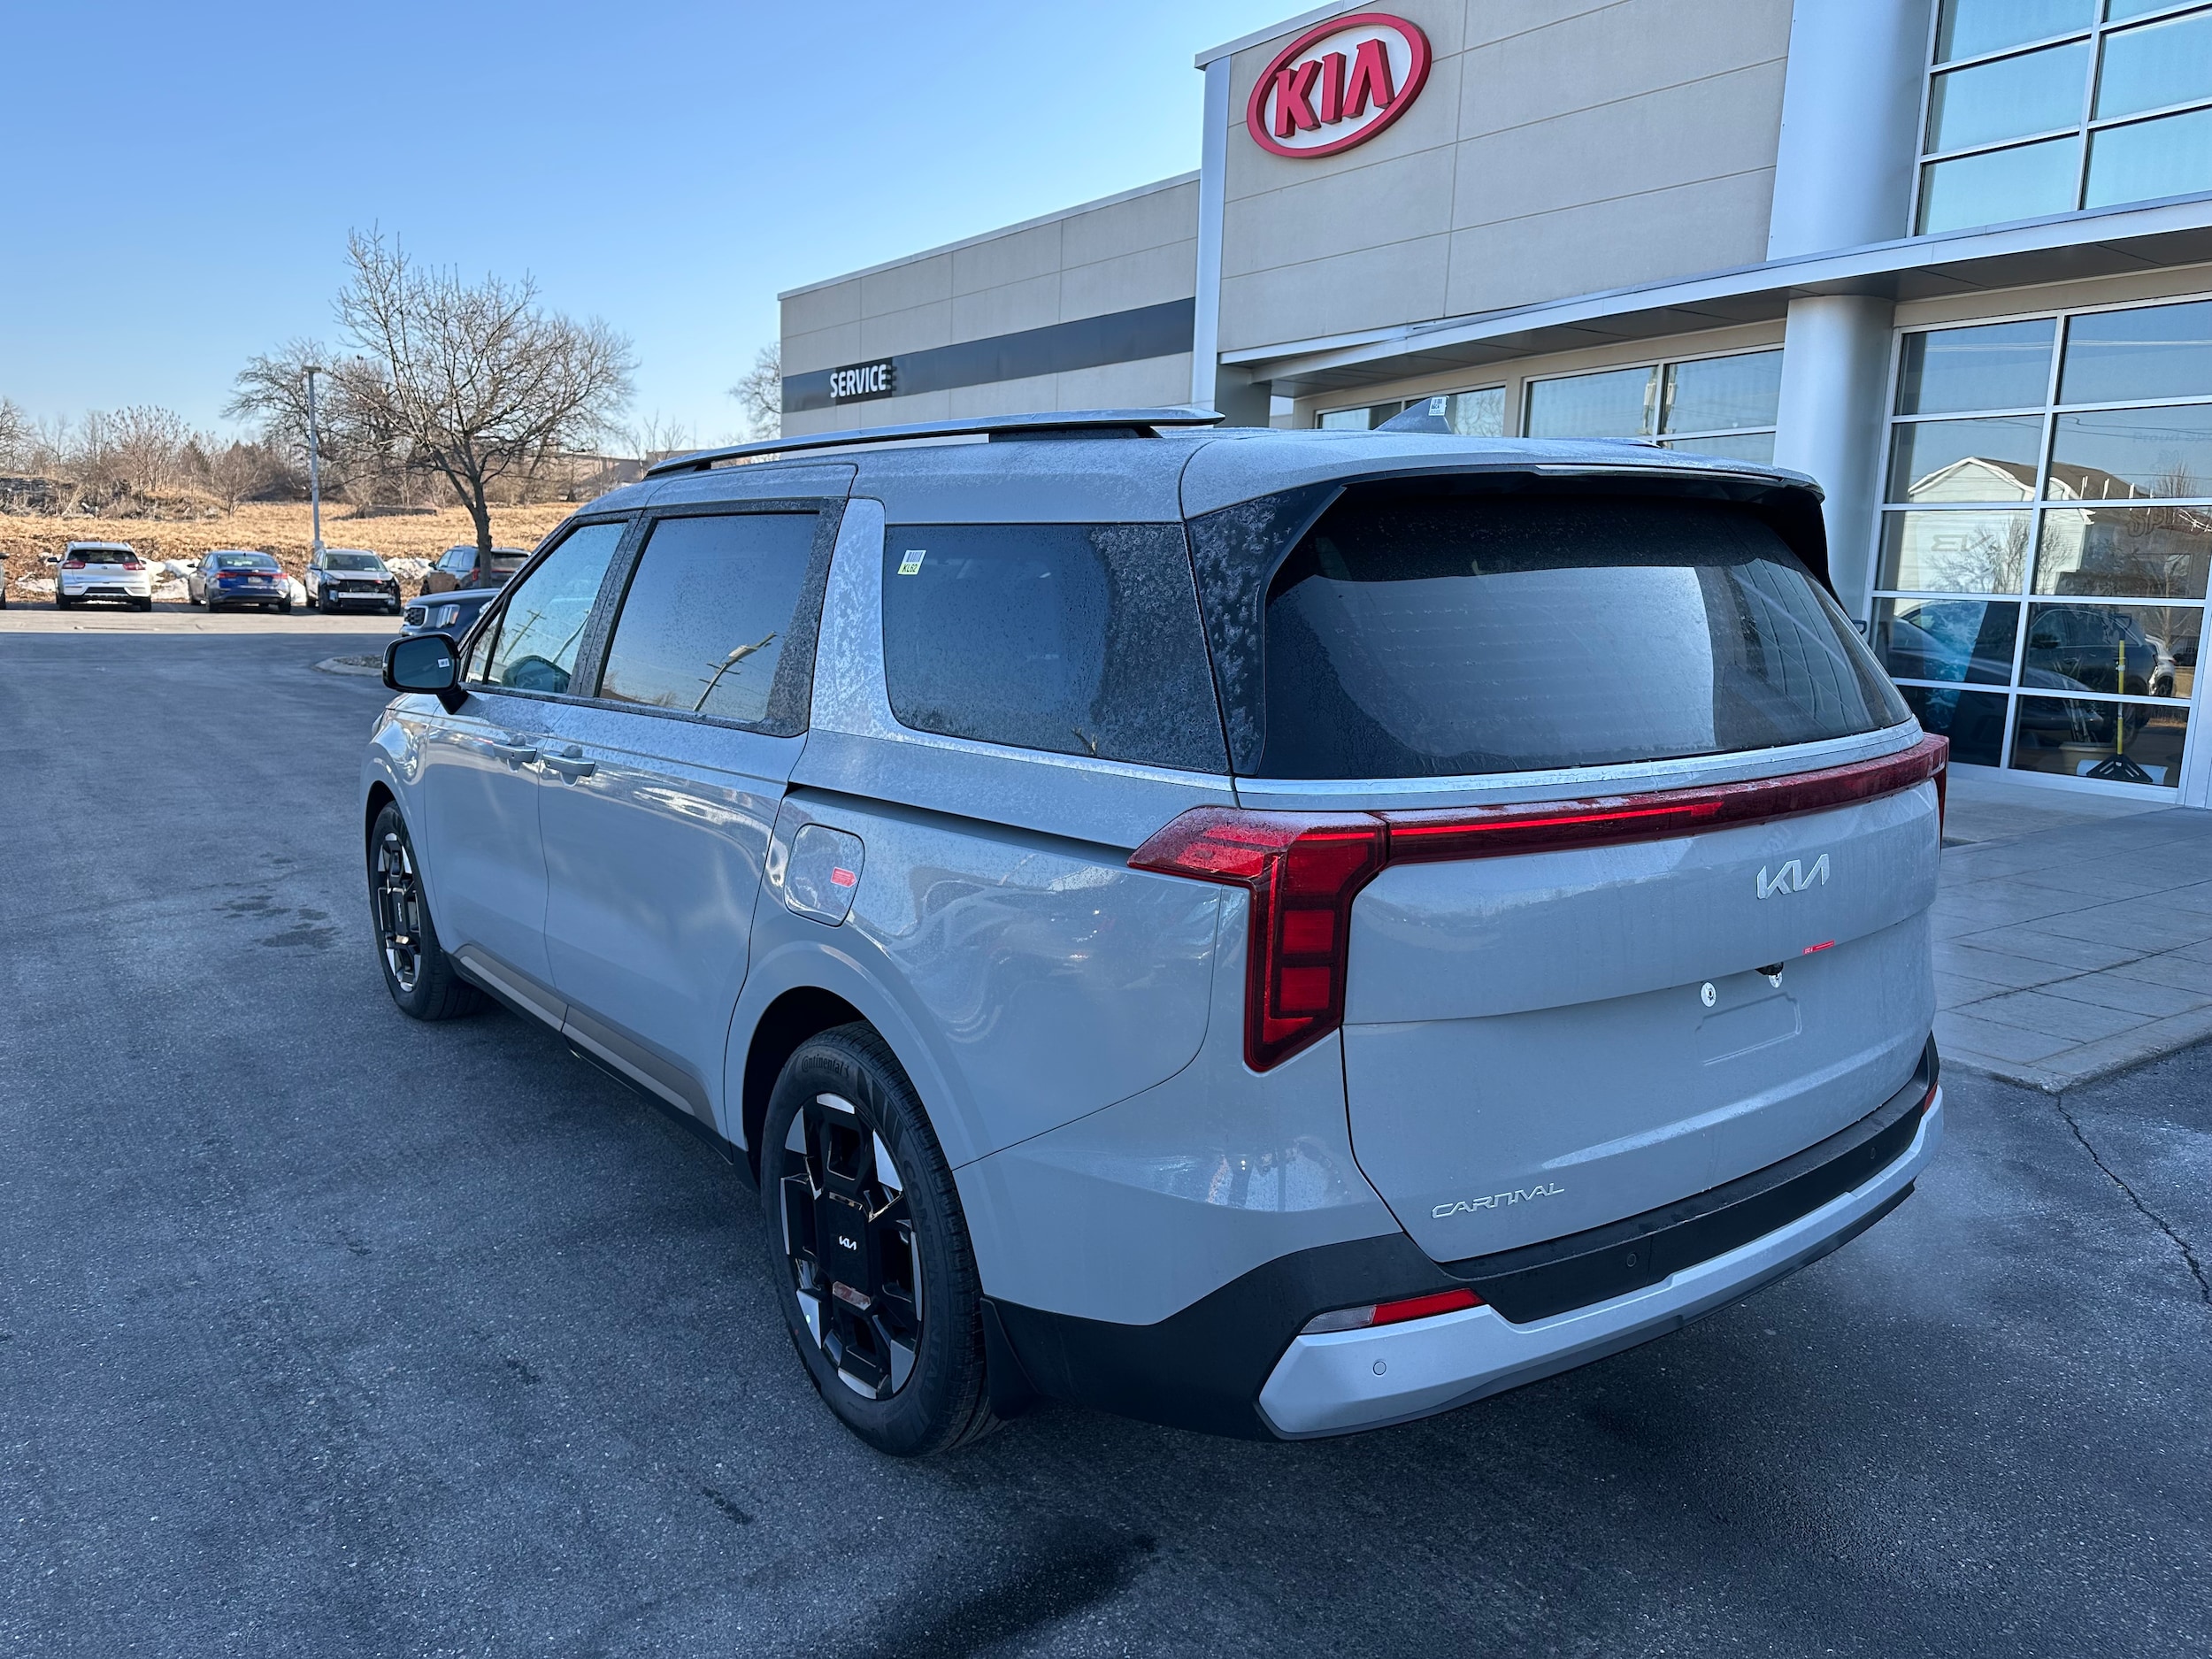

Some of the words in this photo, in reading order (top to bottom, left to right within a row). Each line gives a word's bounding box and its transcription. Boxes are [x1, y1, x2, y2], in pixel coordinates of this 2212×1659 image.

[1274, 38, 1395, 138] KIA
[829, 364, 887, 398] SERVICE
[801, 1053, 845, 1077] Continental
[1431, 1182, 1565, 1219] CARNIVAL
